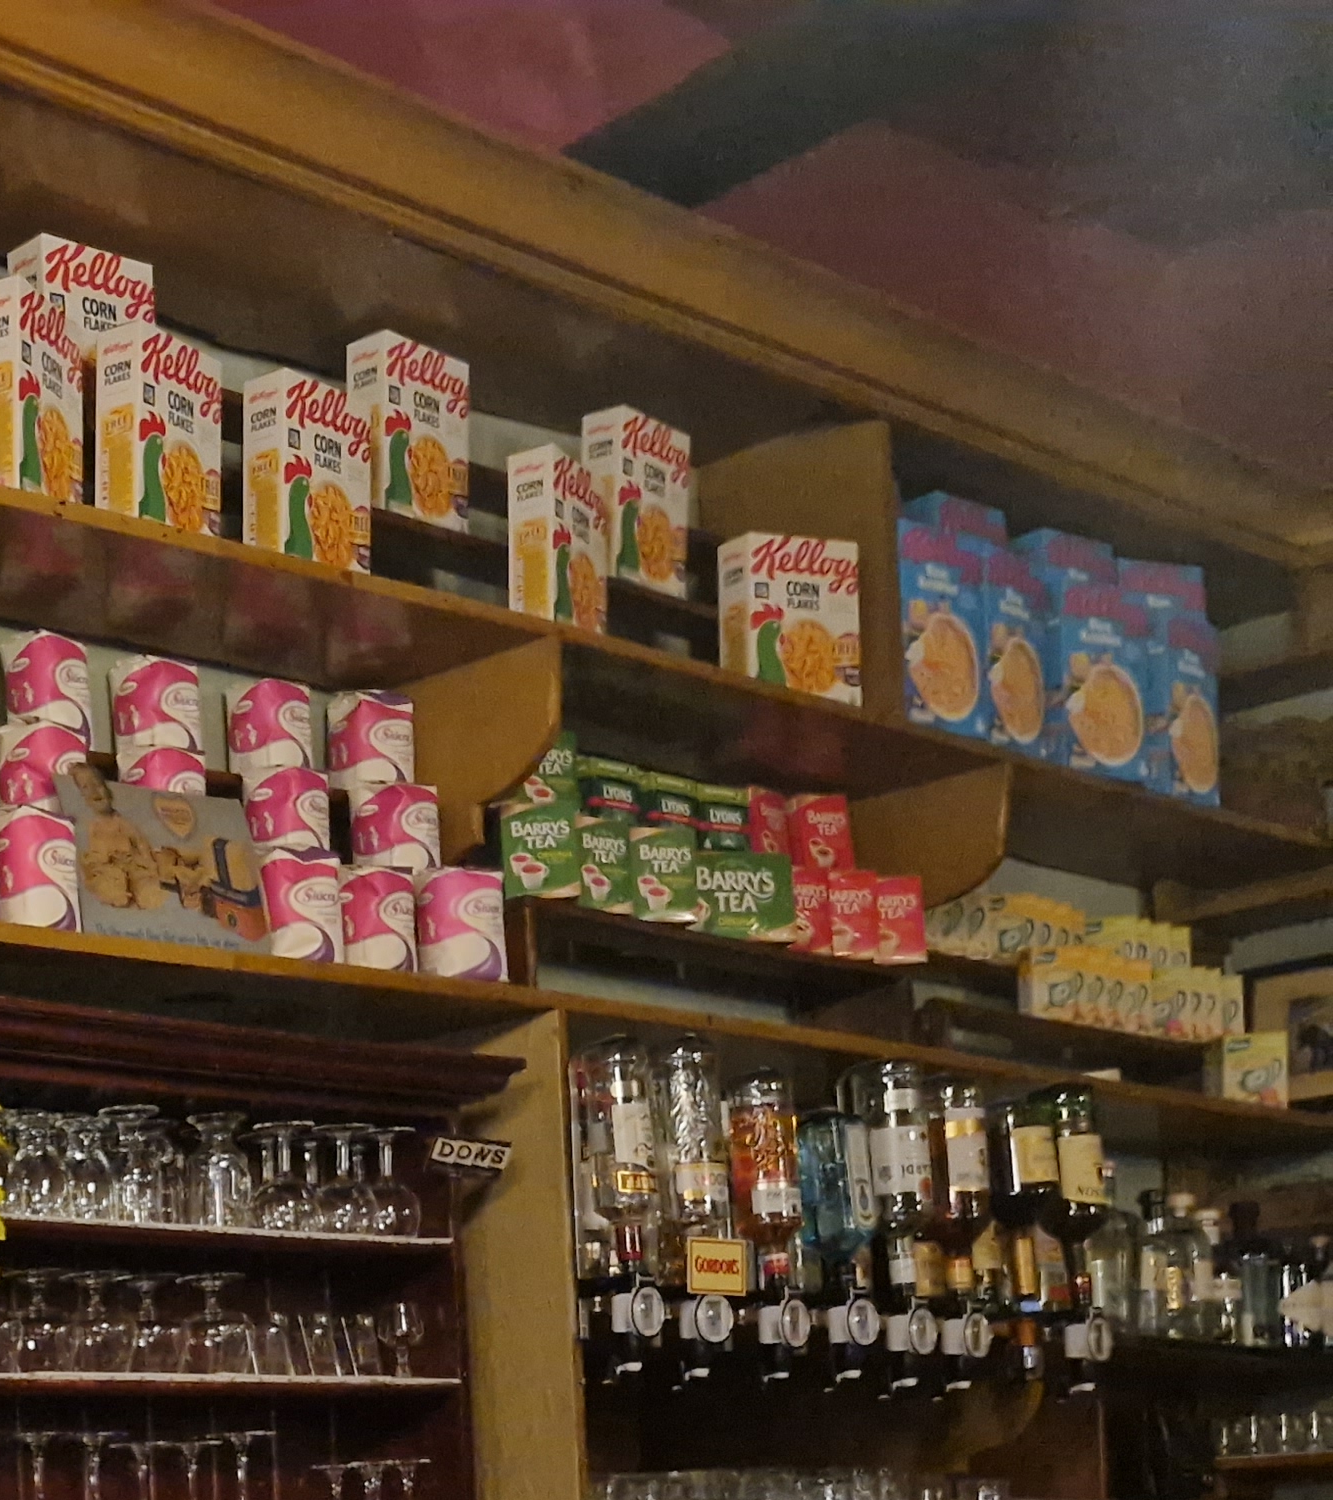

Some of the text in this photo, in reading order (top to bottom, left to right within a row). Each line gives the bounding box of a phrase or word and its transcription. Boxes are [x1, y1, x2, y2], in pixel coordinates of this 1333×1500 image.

[82, 296, 117, 322] CORN
[103, 359, 132, 378] CORN
[352, 364, 378, 383] CORN
[103, 371, 132, 386] FLAKES
[167, 389, 195, 420] CORN
[413, 390, 440, 414] CORN
[167, 412, 195, 434] FLAKES
[250, 407, 277, 424] CORN
[313, 433, 342, 459] CORN
[313, 454, 342, 475] FLAKES
[515, 478, 544, 495] CORN
[785, 580, 821, 599] CORN
[602, 784, 633, 802] LYONS
[661, 799, 691, 817] LYONS
[709, 808, 743, 826] LYONS
[525, 833, 558, 850] TEA
[592, 848, 618, 865] TEA
[650, 858, 680, 874] TEA
[695, 866, 776, 899] BARRY'S
[714, 891, 758, 913] TEA
[836, 902, 861, 915] TEA
